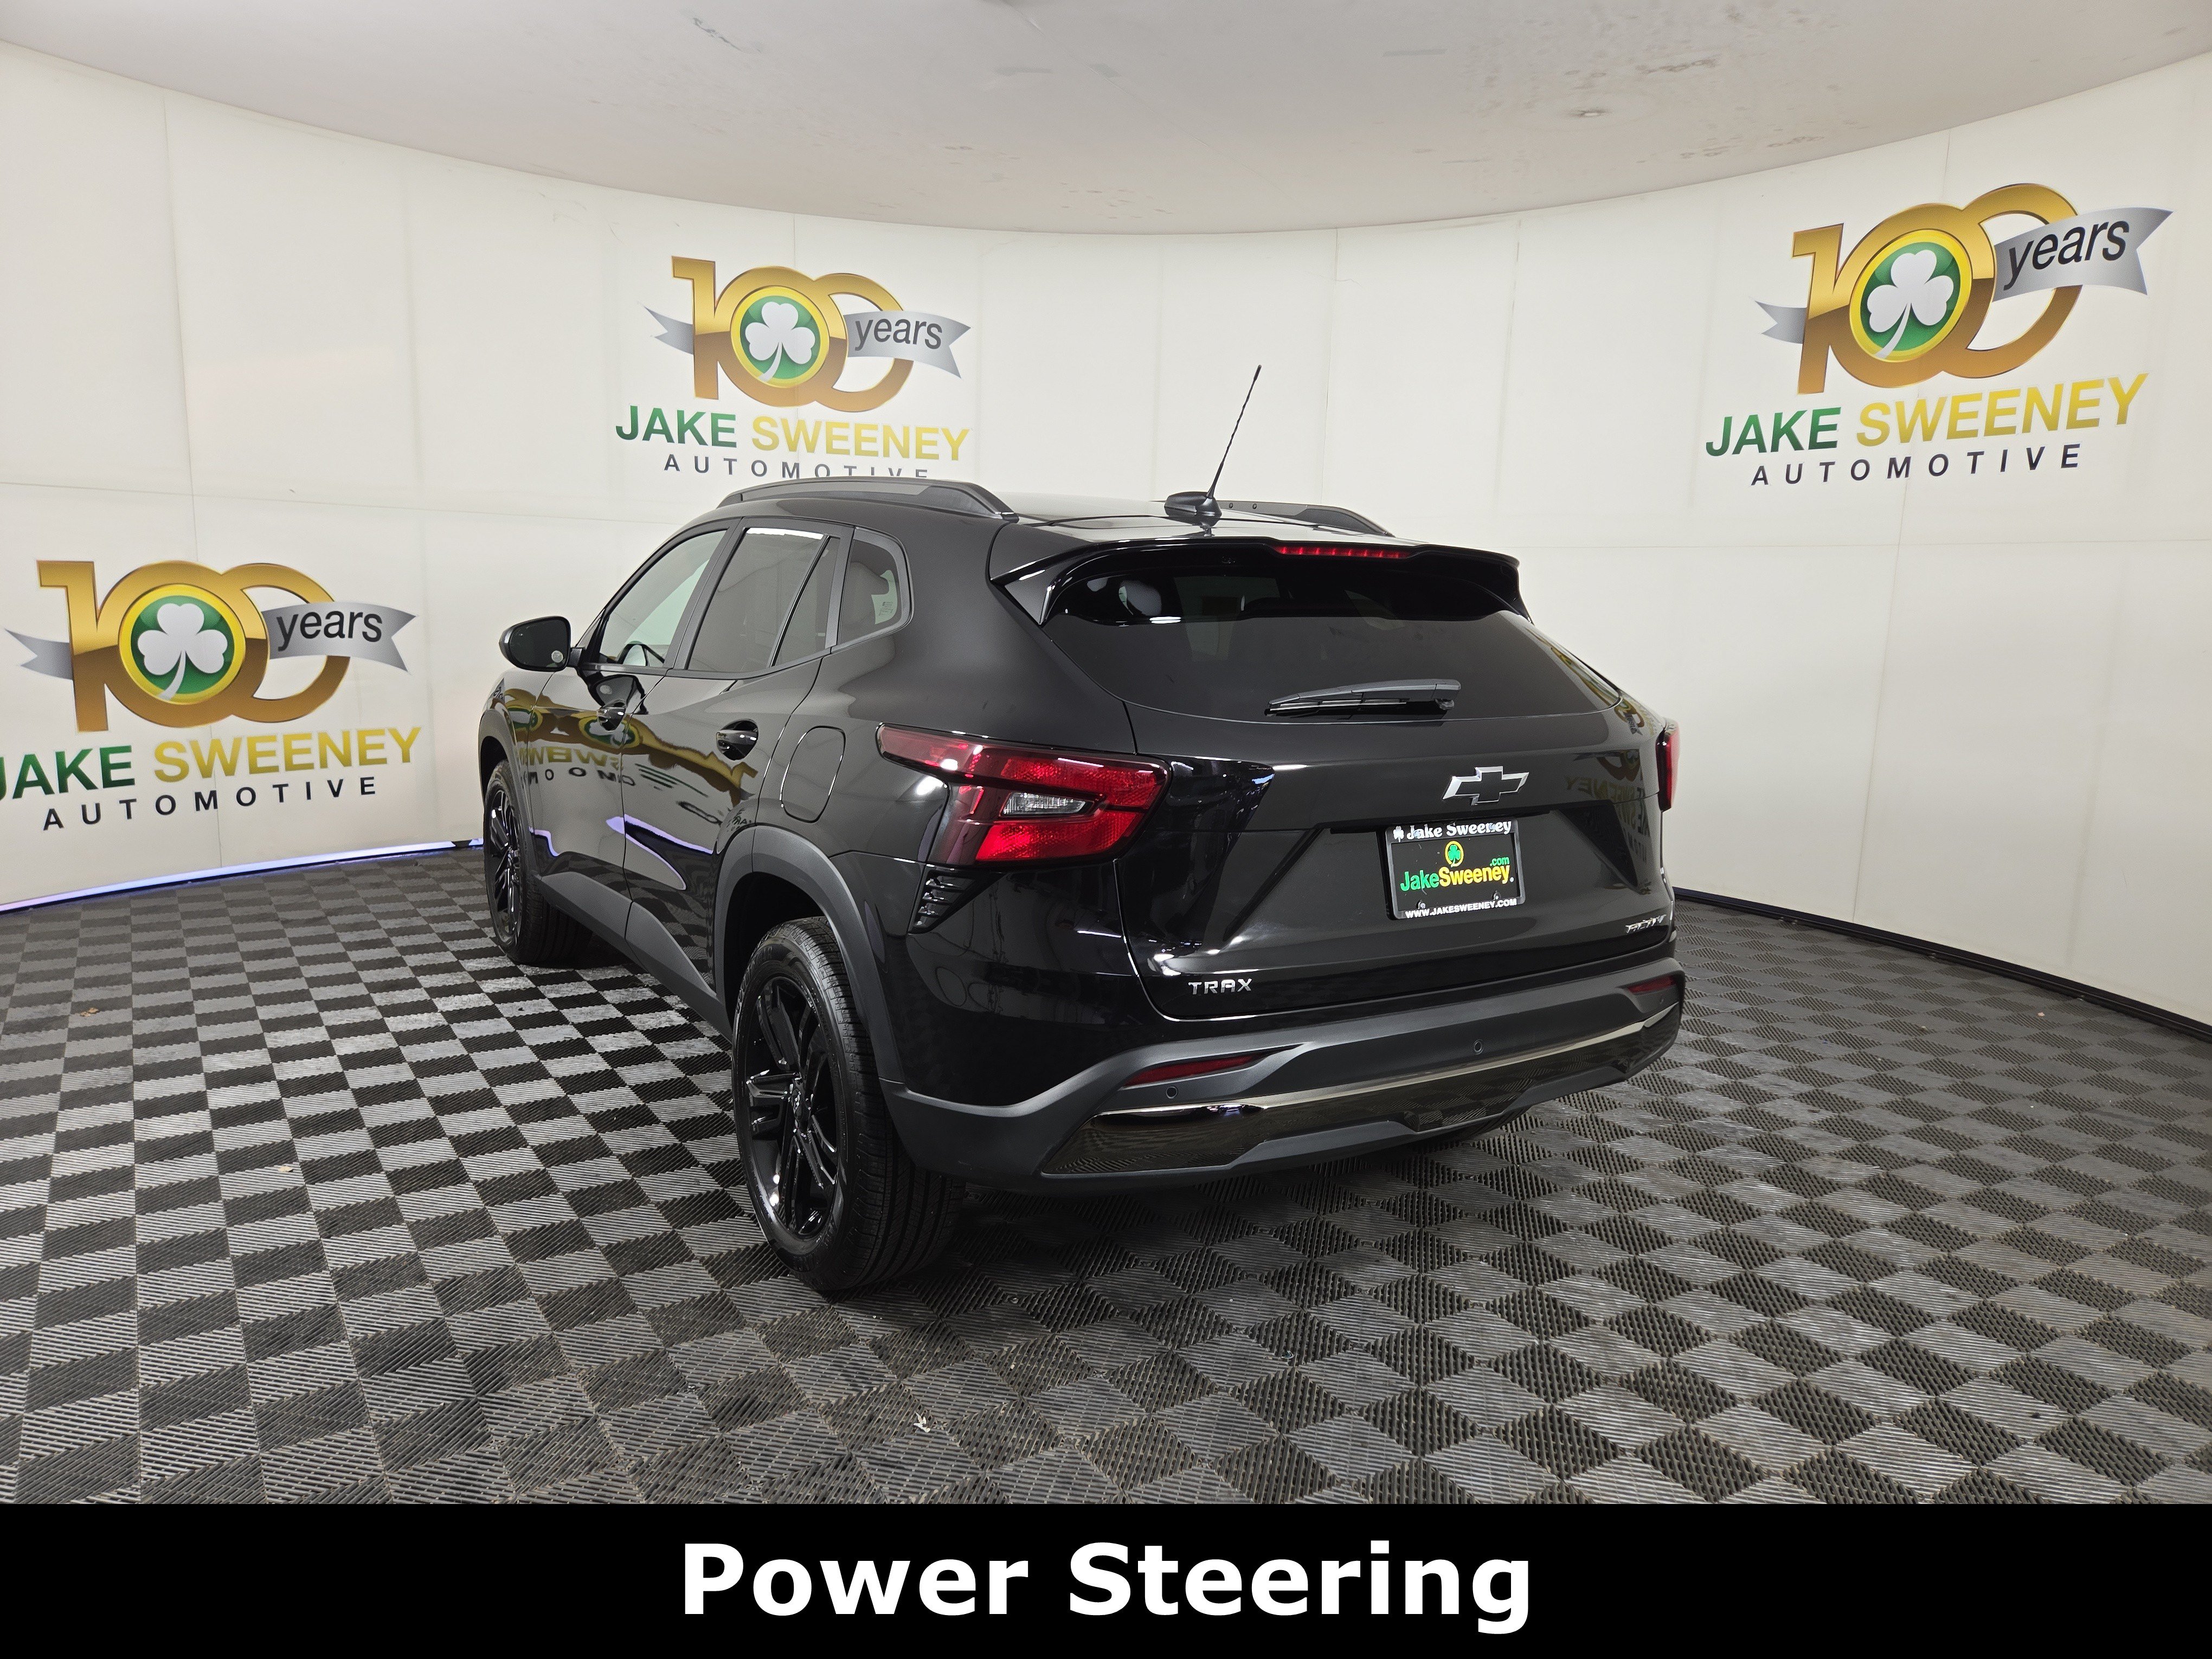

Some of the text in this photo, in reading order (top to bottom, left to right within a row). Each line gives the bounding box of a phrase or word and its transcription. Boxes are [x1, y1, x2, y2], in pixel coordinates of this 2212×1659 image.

[2003, 218, 2129, 291] years
[854, 317, 942, 351] years
[616, 405, 970, 461] JAKE SWEENEY
[1706, 372, 2149, 457] JAKE SWEENEY
[1751, 443, 2081, 486] AUTOMOTIVE
[276, 610, 383, 652] years
[153, 726, 422, 783] SWEENEY
[43, 777, 376, 831] AUTOMOTIVE
[1406, 821, 1512, 840] Jake Sweeney
[1490, 857, 1510, 866] .com
[1405, 898, 1517, 918] WWW.JAKESWEENEY.COM
[1188, 978, 1252, 995] TRAX
